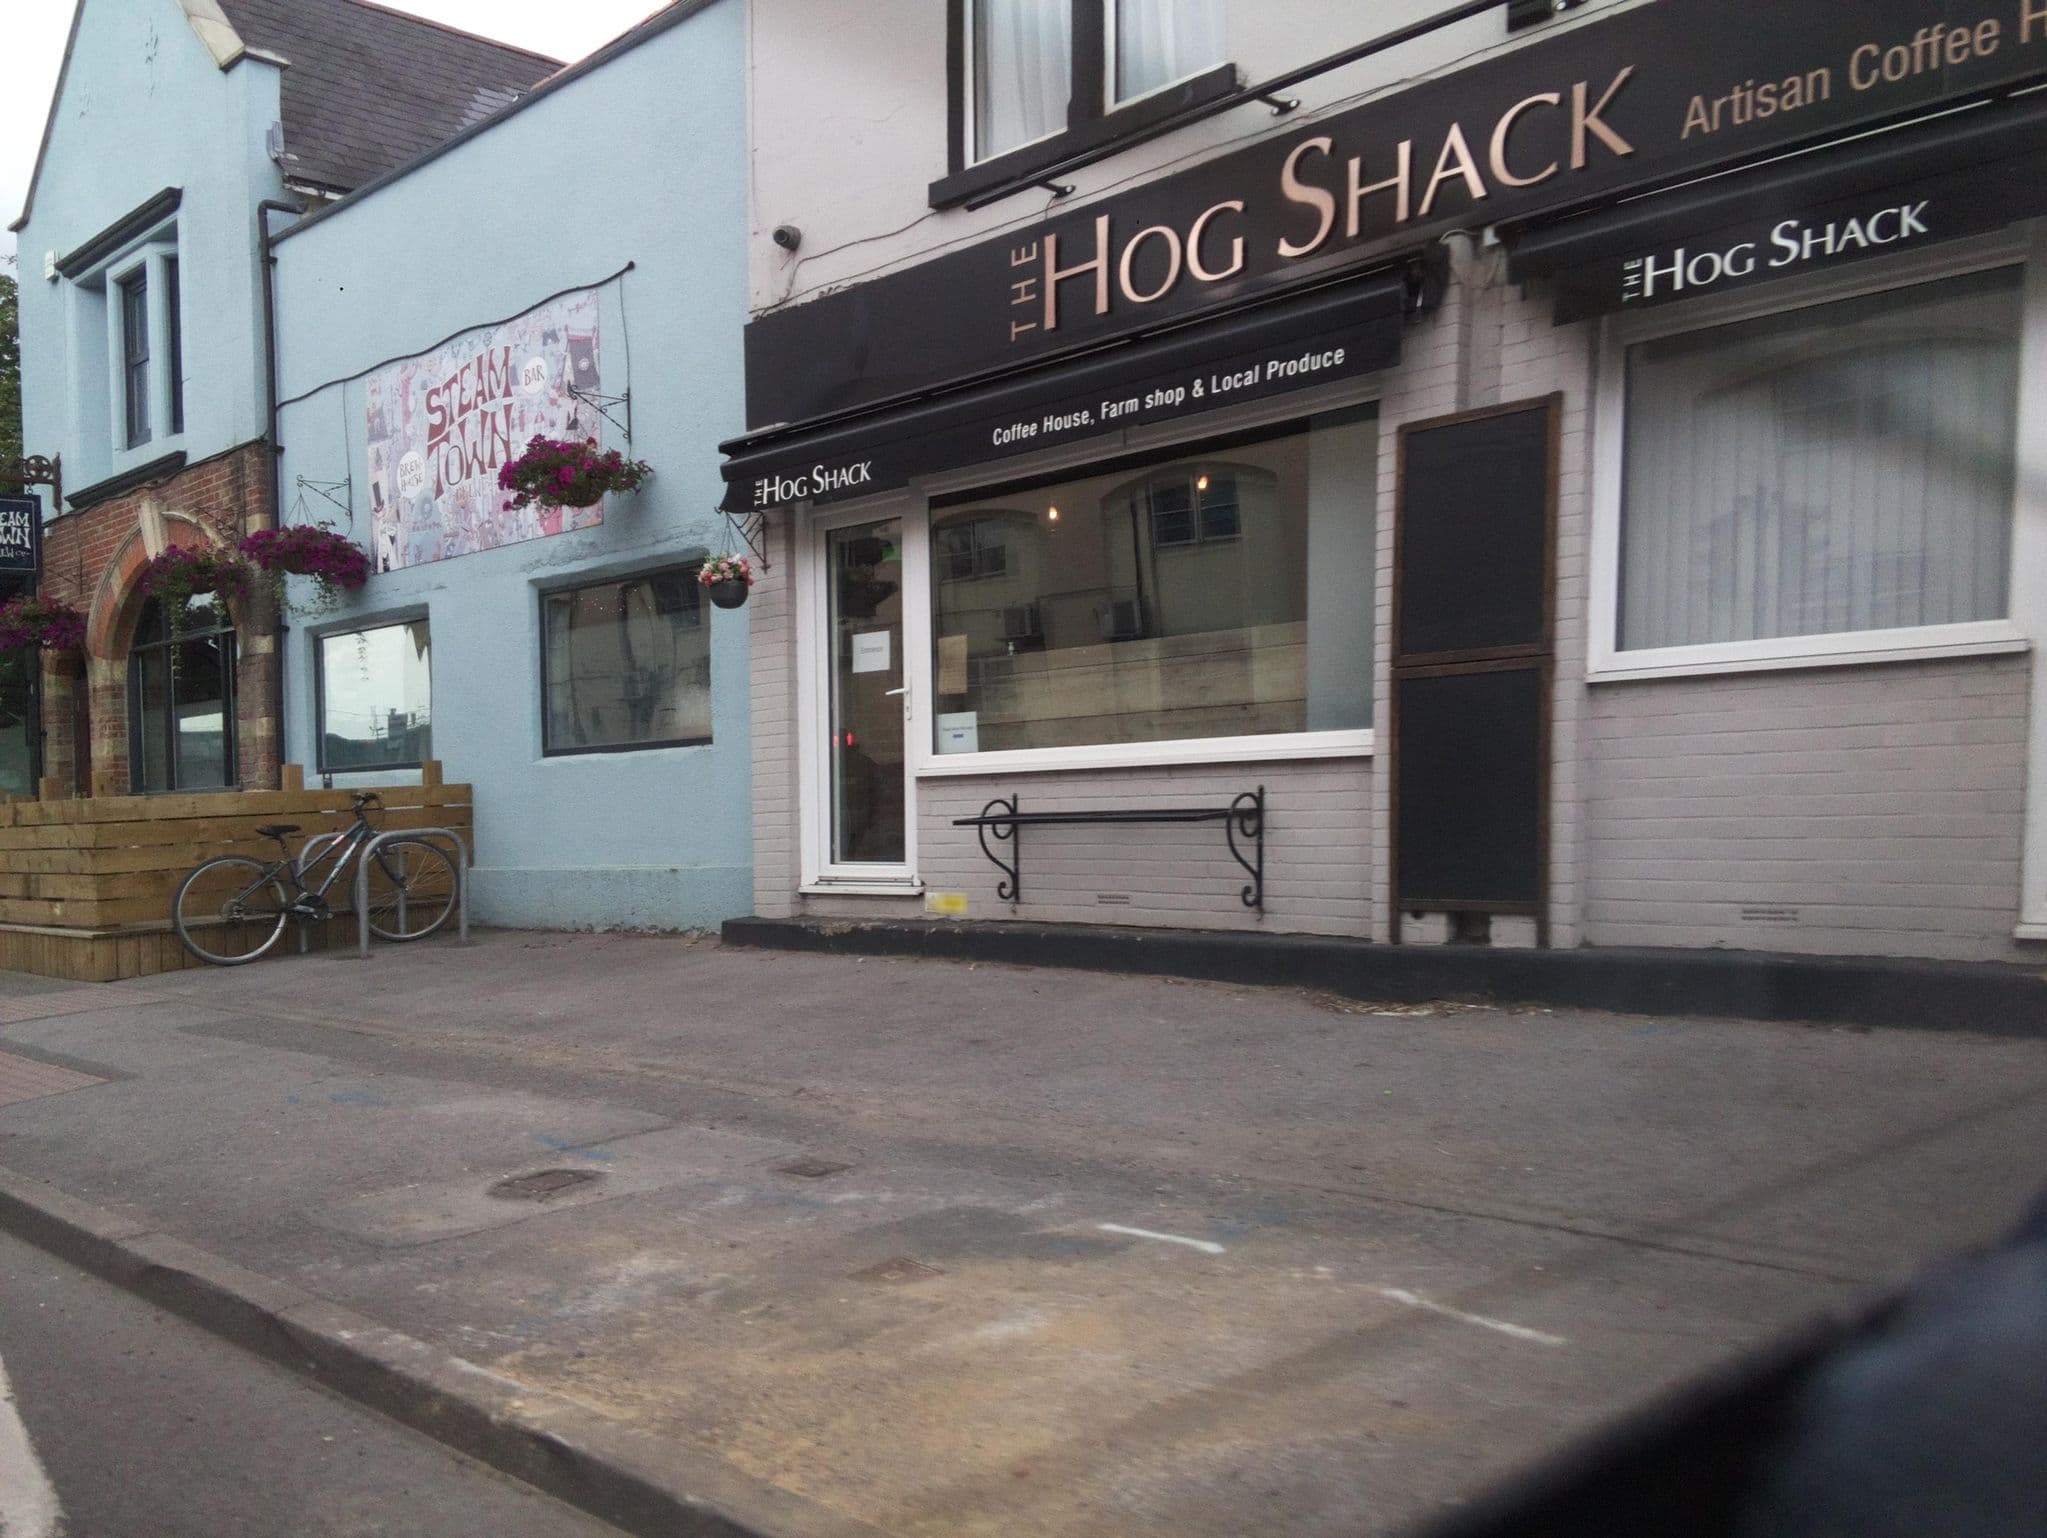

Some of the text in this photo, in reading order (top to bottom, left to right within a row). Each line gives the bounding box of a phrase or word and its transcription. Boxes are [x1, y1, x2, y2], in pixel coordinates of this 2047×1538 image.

[1680, 0, 2047, 140] Artisan Coffee H
[1011, 64, 1635, 341] THE HOG SHACK
[1622, 199, 1929, 301] THE HOG SHACK
[426, 346, 514, 443] STEAM
[524, 364, 546, 387] BAR
[992, 347, 1346, 446] Coffee House, Farm shop & Local Produce
[426, 404, 513, 501] TOWN
[763, 475, 808, 505] HOG
[812, 460, 872, 494] SHACK
[0, 511, 31, 528] EAM
[0, 526, 32, 549] WN
